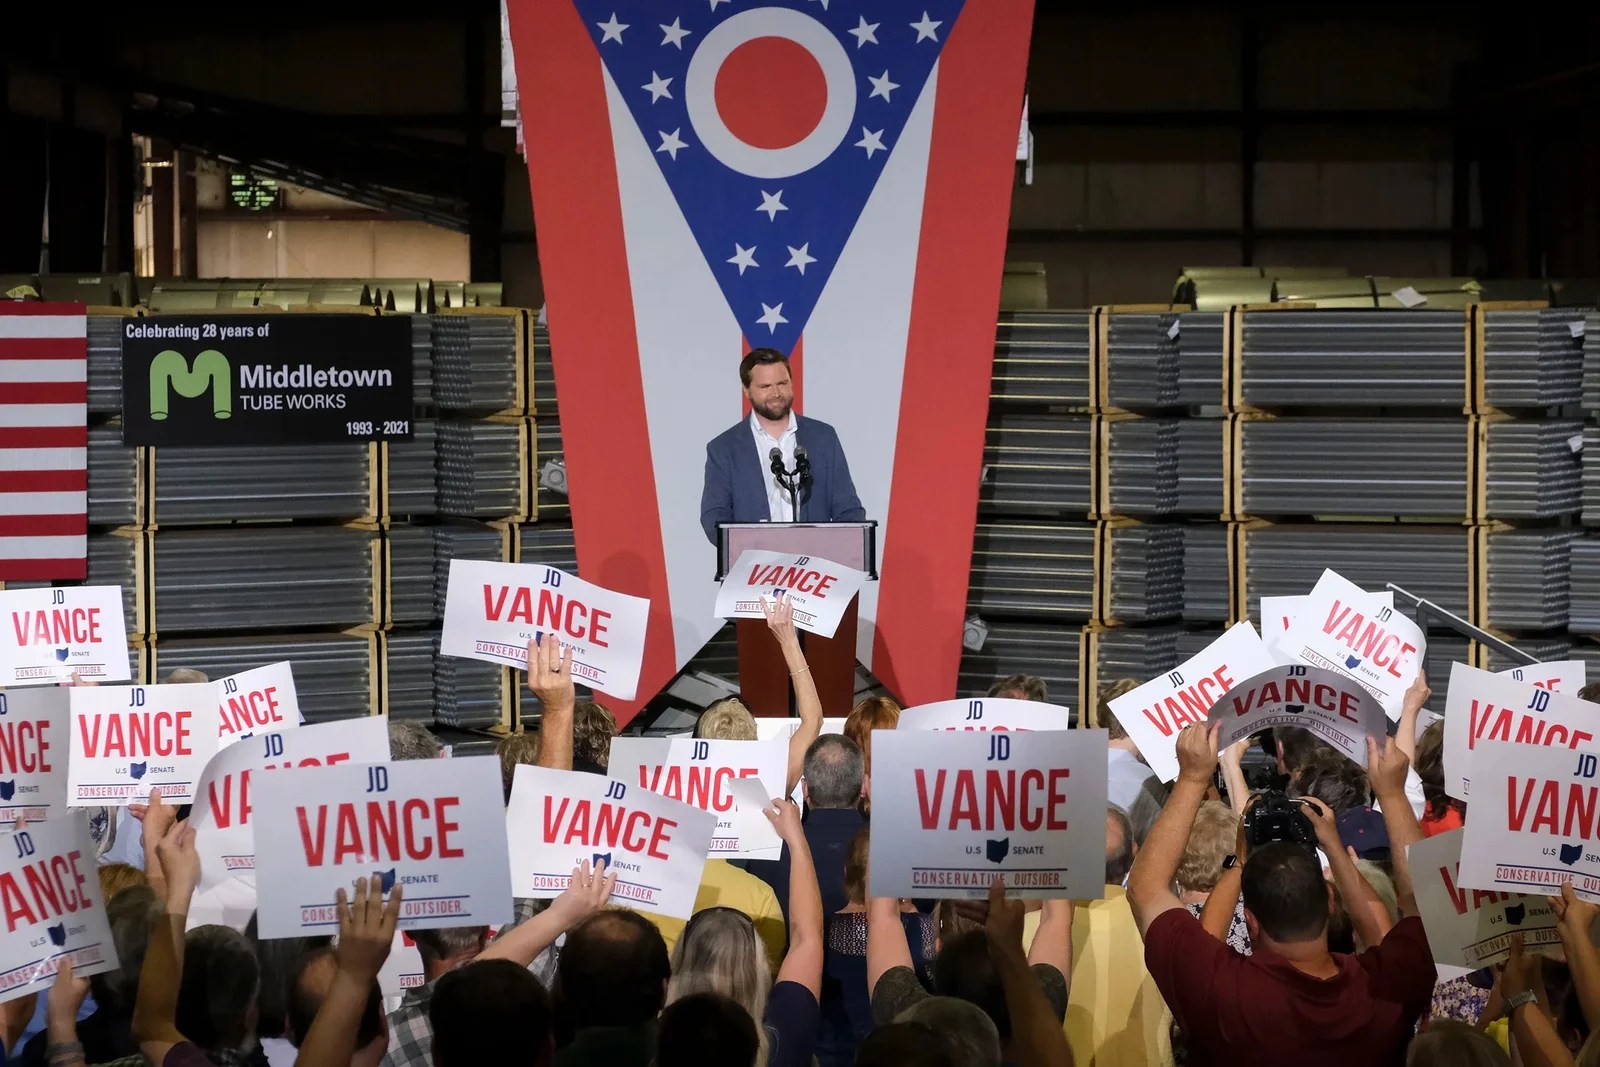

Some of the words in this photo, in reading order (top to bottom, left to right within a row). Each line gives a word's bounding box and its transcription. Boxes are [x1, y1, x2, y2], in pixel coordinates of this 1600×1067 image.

[126, 324, 199, 340] Celebrating
[203, 324, 217, 337] 28
[220, 326, 254, 340] years
[257, 323, 269, 337] of
[240, 364, 392, 388] Middletown
[240, 395, 283, 409] TUBE
[286, 394, 346, 409] WORKS
[346, 422, 373, 435] 1993
[383, 421, 409, 434] 2021
[794, 556, 809, 566] JD
[542, 568, 560, 587] JD
[747, 564, 838, 599] VANCE
[52, 590, 64, 604] JD
[483, 584, 611, 648] VANCE
[1375, 606, 1392, 622] JD
[12, 608, 102, 646] VANCE
[1322, 600, 1416, 678] VANCE
[476, 643, 527, 660] CONSERVA
[1168, 671, 1185, 688] JD
[1287, 666, 1306, 676] JD
[1360, 666, 1380, 680] SENATE
[224, 678, 237, 694] JD
[0, 693, 7, 715] D
[129, 688, 145, 707] JD
[1142, 664, 1234, 737] VANCE
[1233, 679, 1359, 723] VANCE
[1528, 689, 1550, 712] JD
[219, 687, 283, 737] ANCE
[966, 701, 983, 720] JD
[1308, 709, 1337, 723] SENATE
[78, 711, 192, 758] VANCE
[0, 720, 51, 774] NCE
[264, 734, 283, 758] JD
[691, 741, 709, 760] JD
[987, 735, 1010, 760] JD
[1574, 754, 1598, 779] JD
[367, 766, 388, 792] JD
[605, 781, 626, 800] JD
[914, 768, 1070, 831] VANCE
[1508, 776, 1600, 841] VAN
[296, 797, 464, 867] VANCE
[543, 796, 678, 860] VANCE
[14, 832, 34, 858] JD
[966, 846, 981, 854] U.S
[1013, 846, 1044, 854] SENATE
[1543, 848, 1556, 856] U.S
[1585, 854, 1600, 863] SEN
[613, 860, 641, 872] SENATE
[401, 874, 438, 884] SENATE
[0, 851, 91, 932] ANCE
[1490, 915, 1503, 924] U.S
[30, 937, 46, 947] U.S
